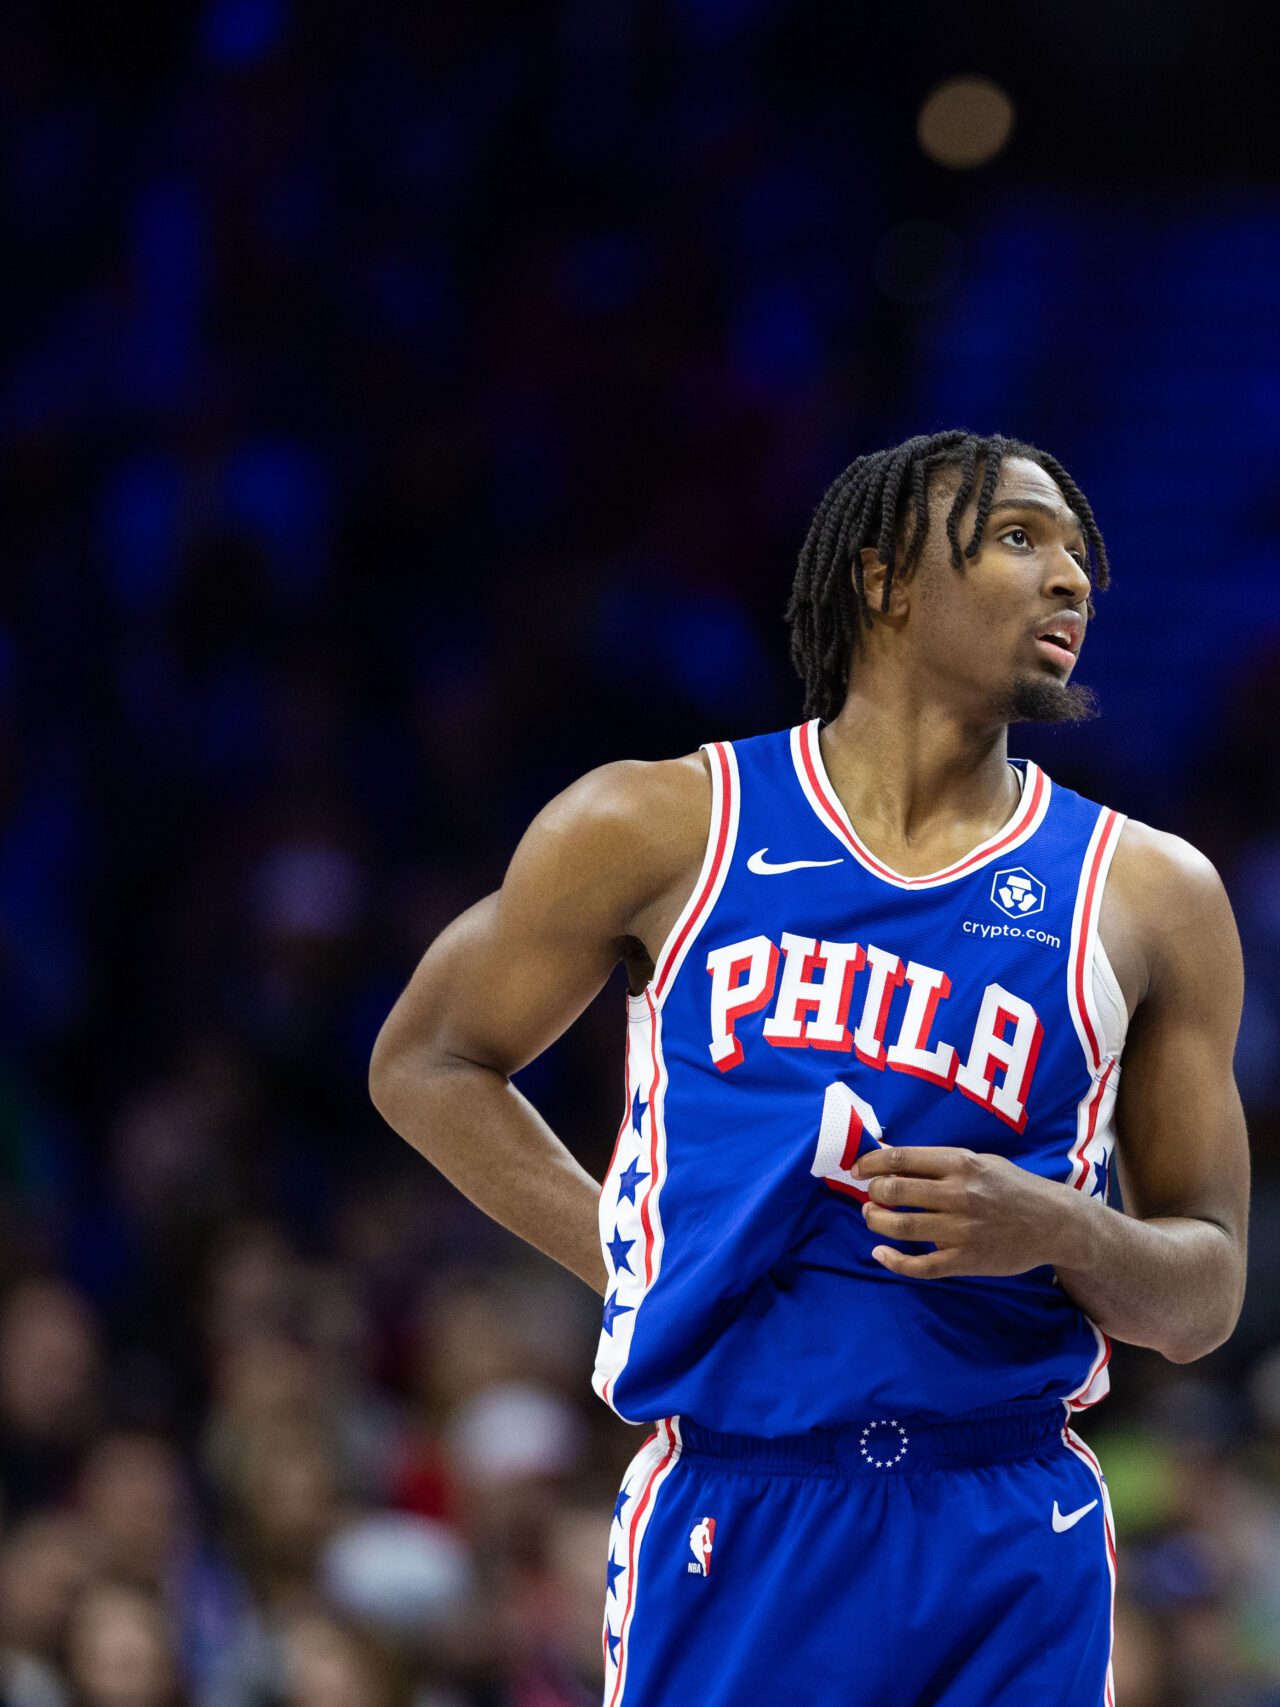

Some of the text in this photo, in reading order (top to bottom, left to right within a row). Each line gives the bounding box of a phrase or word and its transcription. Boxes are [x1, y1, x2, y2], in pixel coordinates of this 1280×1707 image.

[963, 921, 1060, 948] crypto.com
[706, 932, 1044, 1135] PHILA
[687, 1562, 701, 1574] NBA
